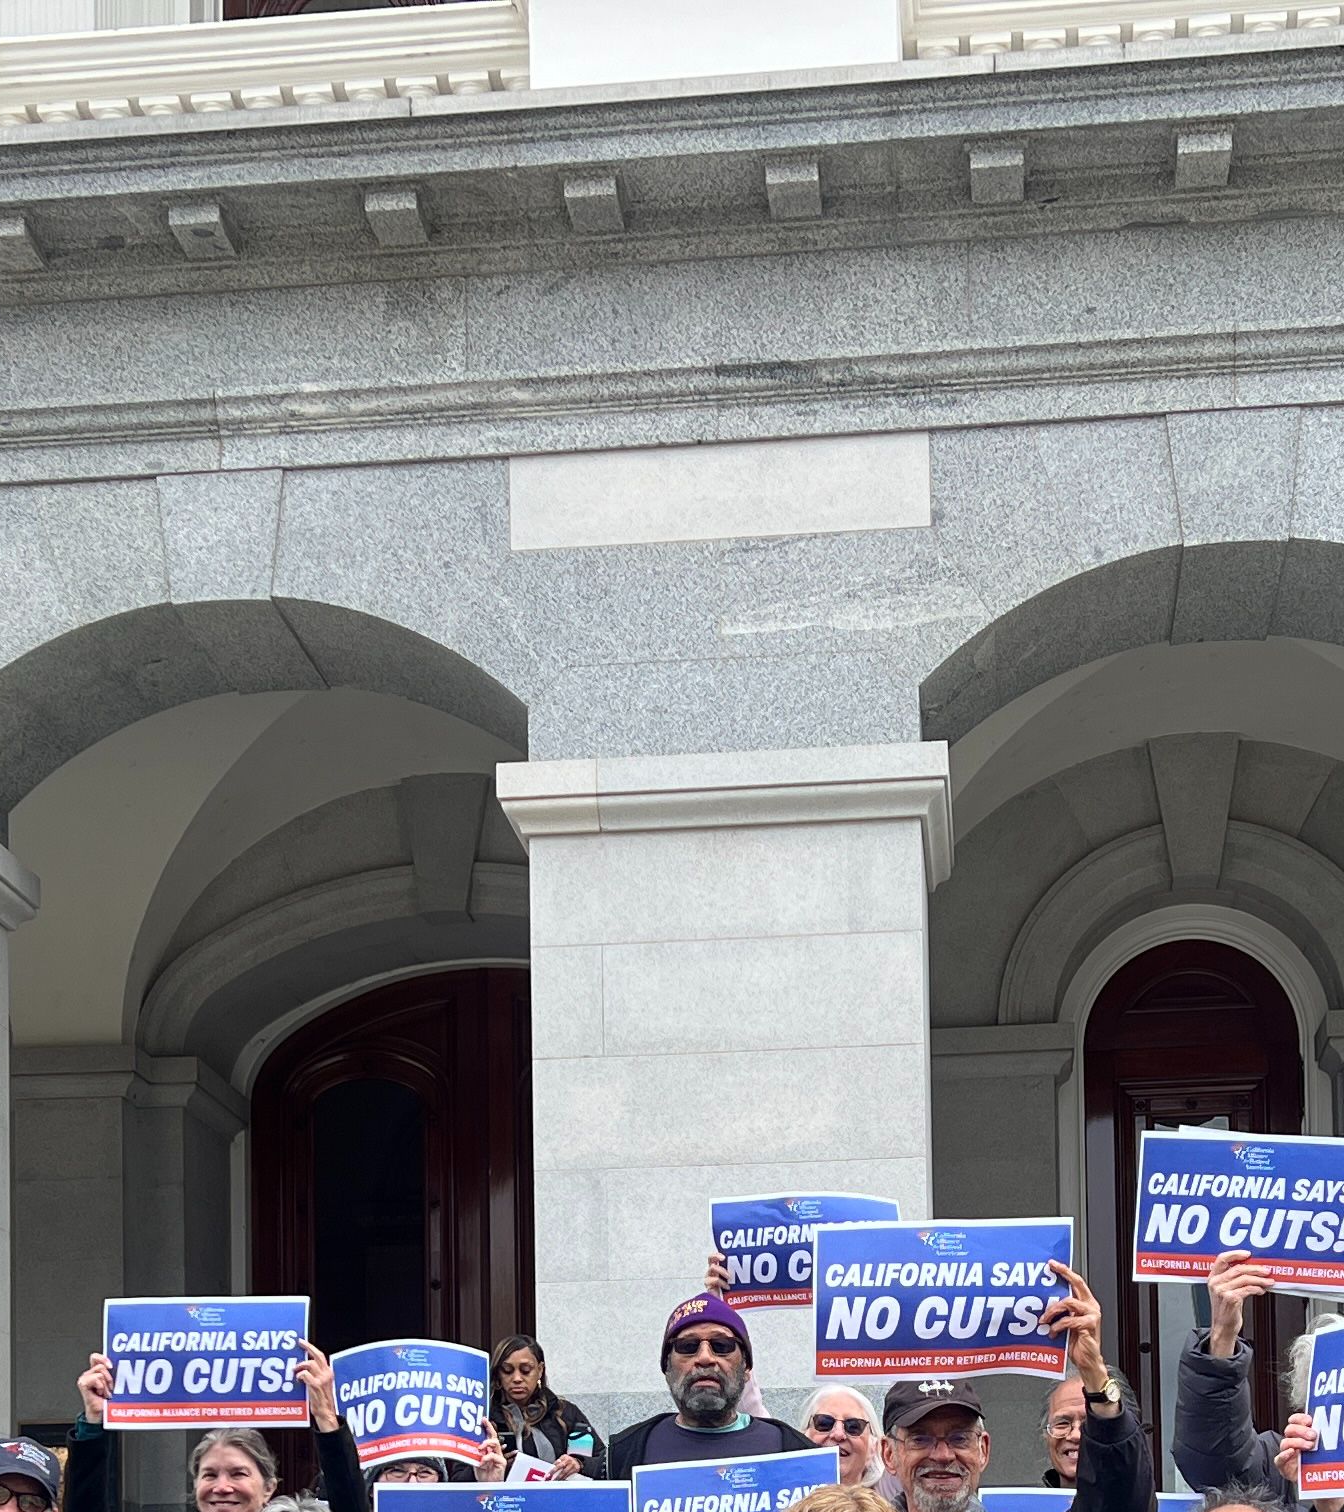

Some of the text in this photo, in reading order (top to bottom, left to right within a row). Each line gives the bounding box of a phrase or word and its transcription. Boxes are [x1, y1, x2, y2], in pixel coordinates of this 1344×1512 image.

[1148, 1173, 1286, 1200] CALIFORNIA
[720, 1224, 814, 1249] CALIFORN
[1144, 1203, 1210, 1245] NO
[726, 1253, 777, 1284] NO
[825, 1262, 984, 1287] CALIFORNIA
[990, 1262, 1057, 1287] SAYS
[1141, 1259, 1190, 1270] CALIFORNIA
[728, 1294, 772, 1305] CALIFORNIA
[825, 1296, 900, 1340] NO
[112, 1330, 297, 1352] CALIFORNIA SAYS
[821, 1351, 1059, 1368] CALIFORNIA ALLIANCE FOR RETIRED AMERICANS
[113, 1357, 297, 1395] NO CUTS!
[340, 1371, 484, 1402] CALIFORNIA SAYS
[111, 1406, 303, 1417] CALIFORNIA ALLIANCE FOR RETIRED AMERICANS
[346, 1394, 484, 1437] NO CUTS!
